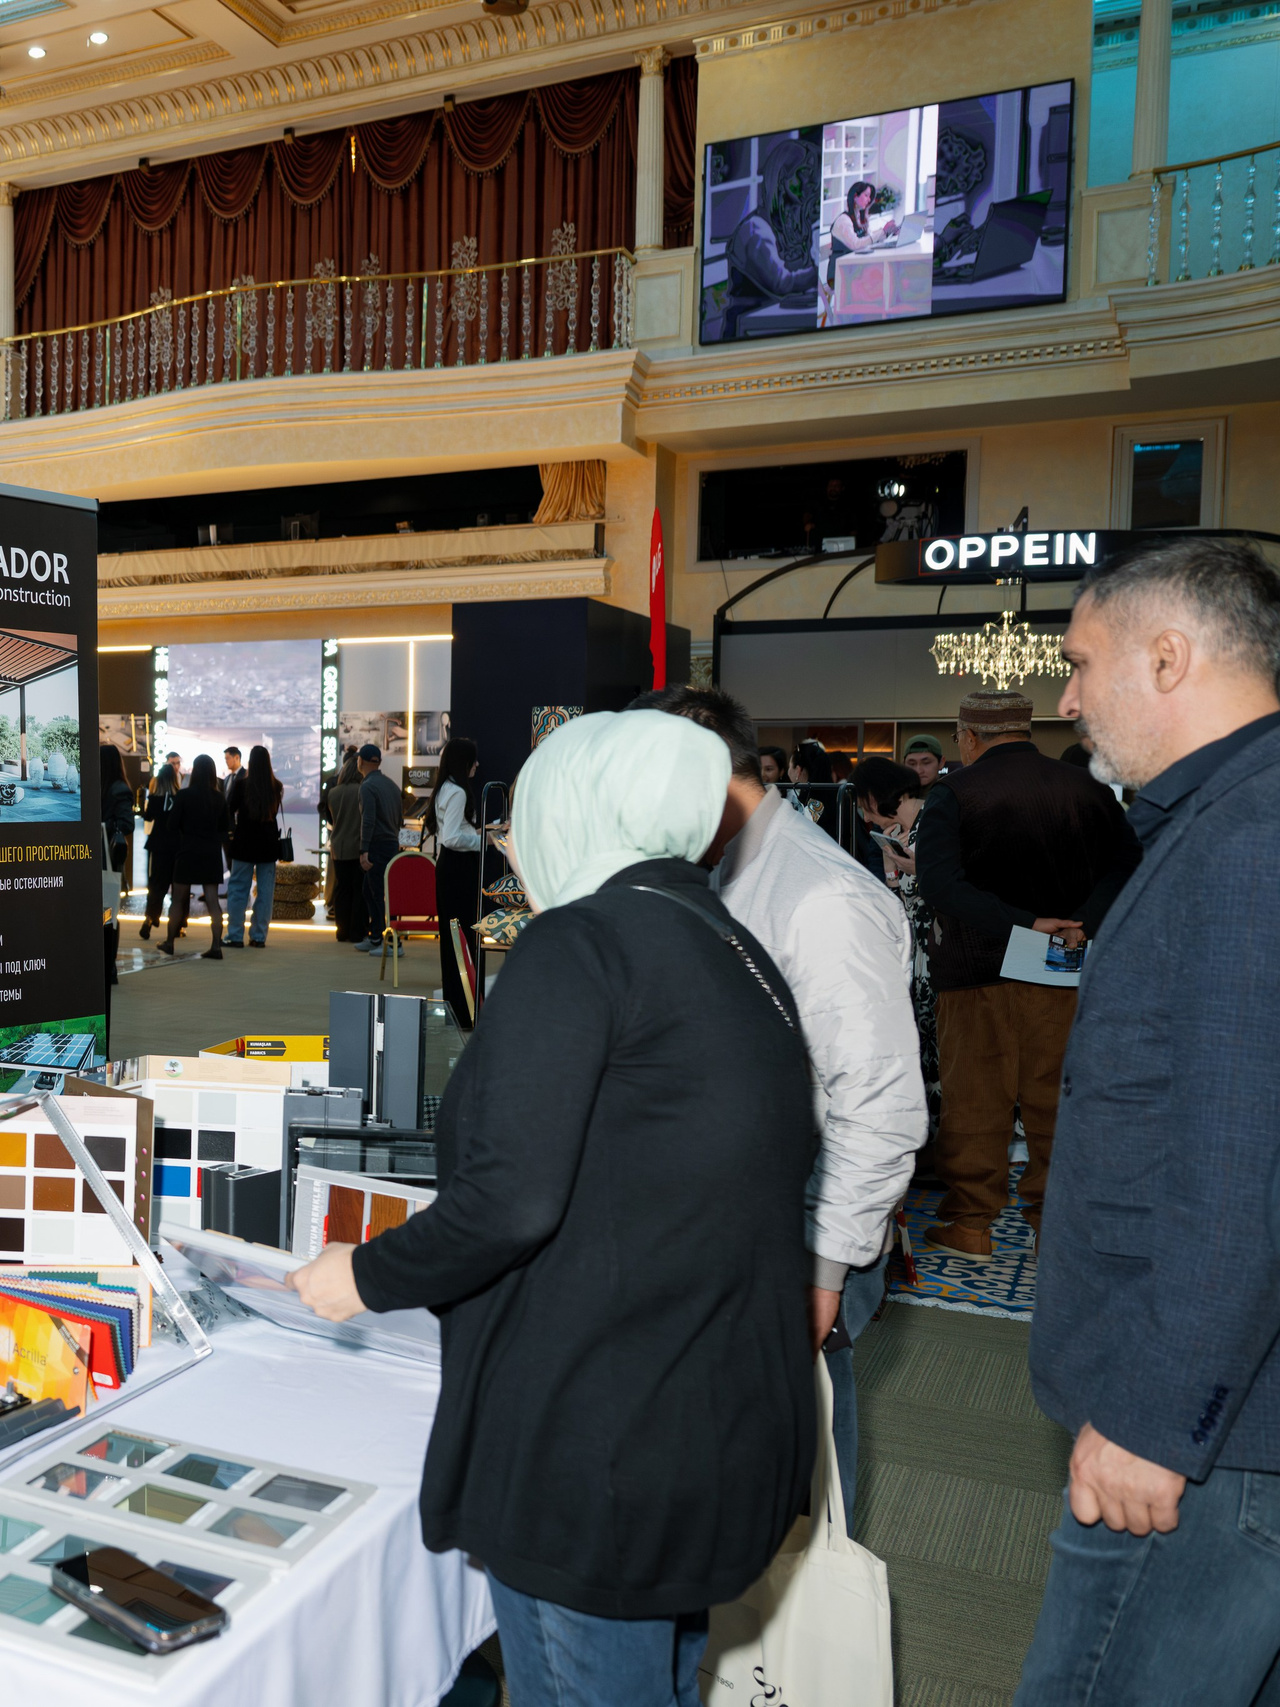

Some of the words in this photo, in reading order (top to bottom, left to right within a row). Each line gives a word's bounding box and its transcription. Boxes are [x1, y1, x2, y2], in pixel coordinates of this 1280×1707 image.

[924, 532, 1097, 571] OPPEIN
[322, 666, 338, 730] GROHE
[322, 736, 337, 772] SPA
[408, 770, 430, 778] GROHE
[25, 844, 93, 862] ПРОСТРАНСТВА:
[13, 876, 64, 890] остекления
[5, 960, 22, 976] под
[23, 958, 46, 972] ключ
